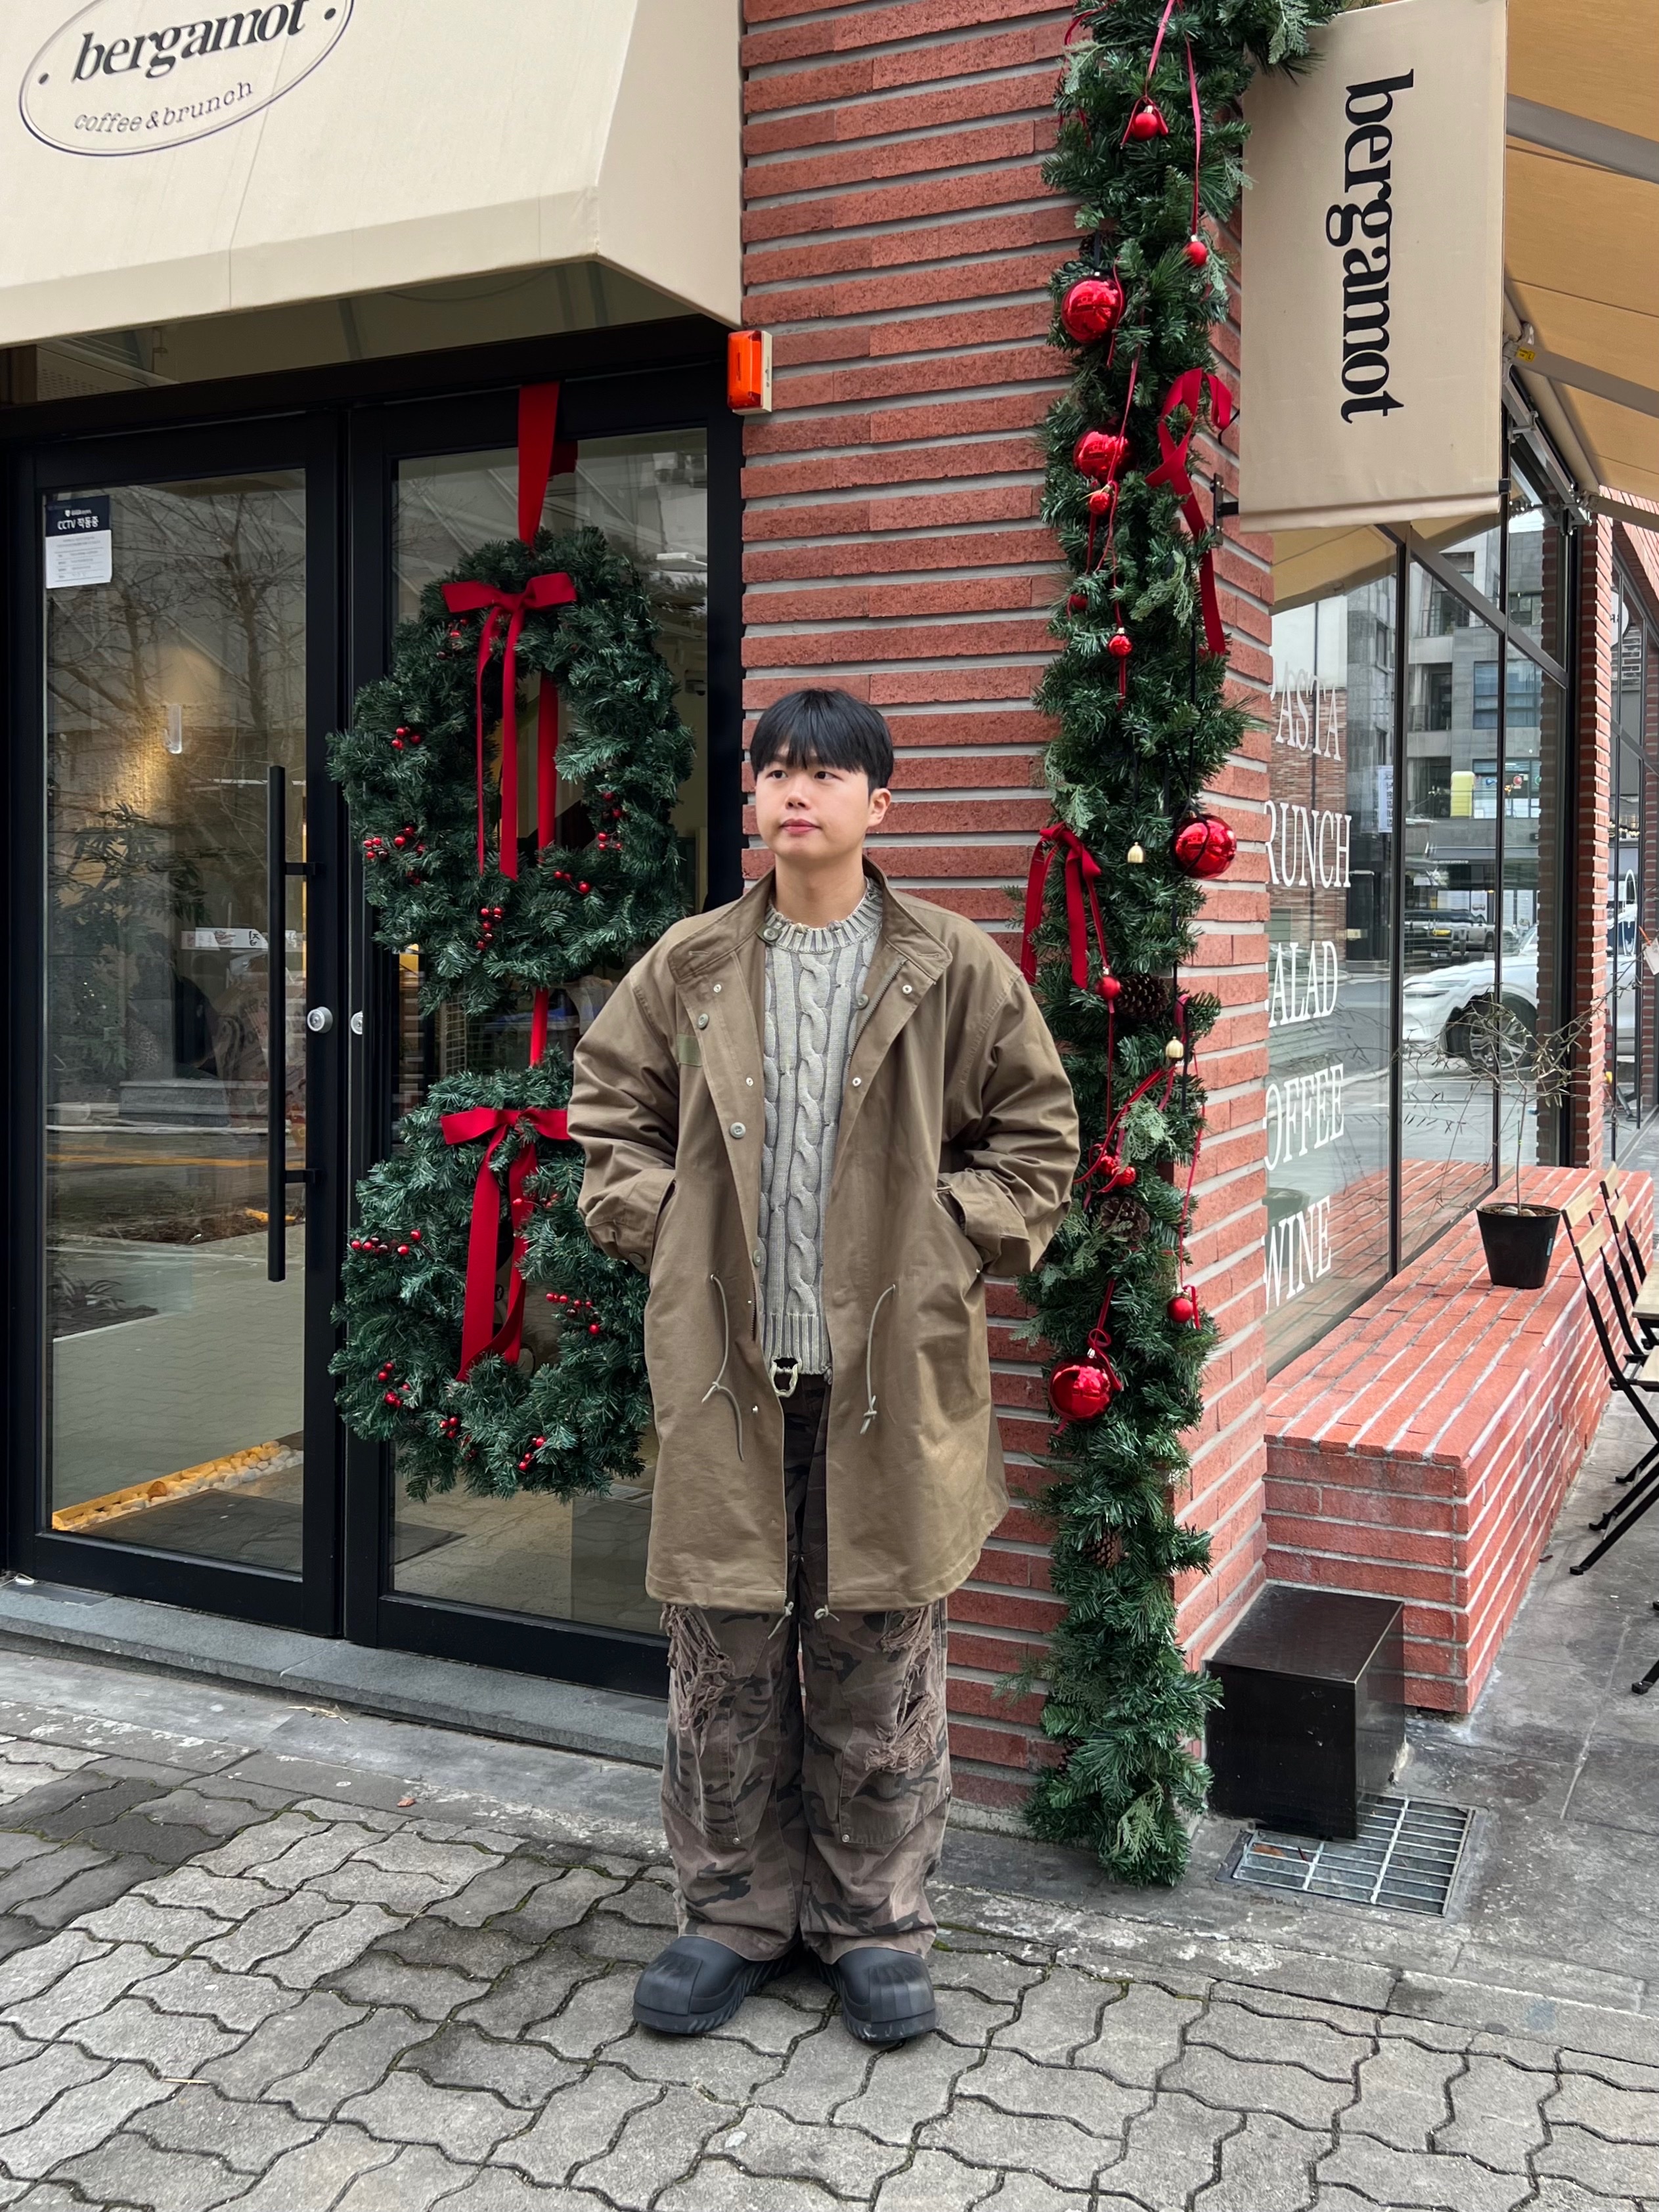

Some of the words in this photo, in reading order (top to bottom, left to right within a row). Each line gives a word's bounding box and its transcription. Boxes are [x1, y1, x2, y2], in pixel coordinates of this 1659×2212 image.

[71, 0, 309, 83] bergamot
[1325, 68, 1414, 423] bergamot
[57, 519, 76, 530] CCTV
[1270, 657, 1341, 761] ASTA
[1264, 800, 1352, 888] RUNCH
[1265, 940, 1338, 1028] ALAD
[1262, 1063, 1344, 1171] OFFEE
[1261, 1195, 1331, 1314] WINE
